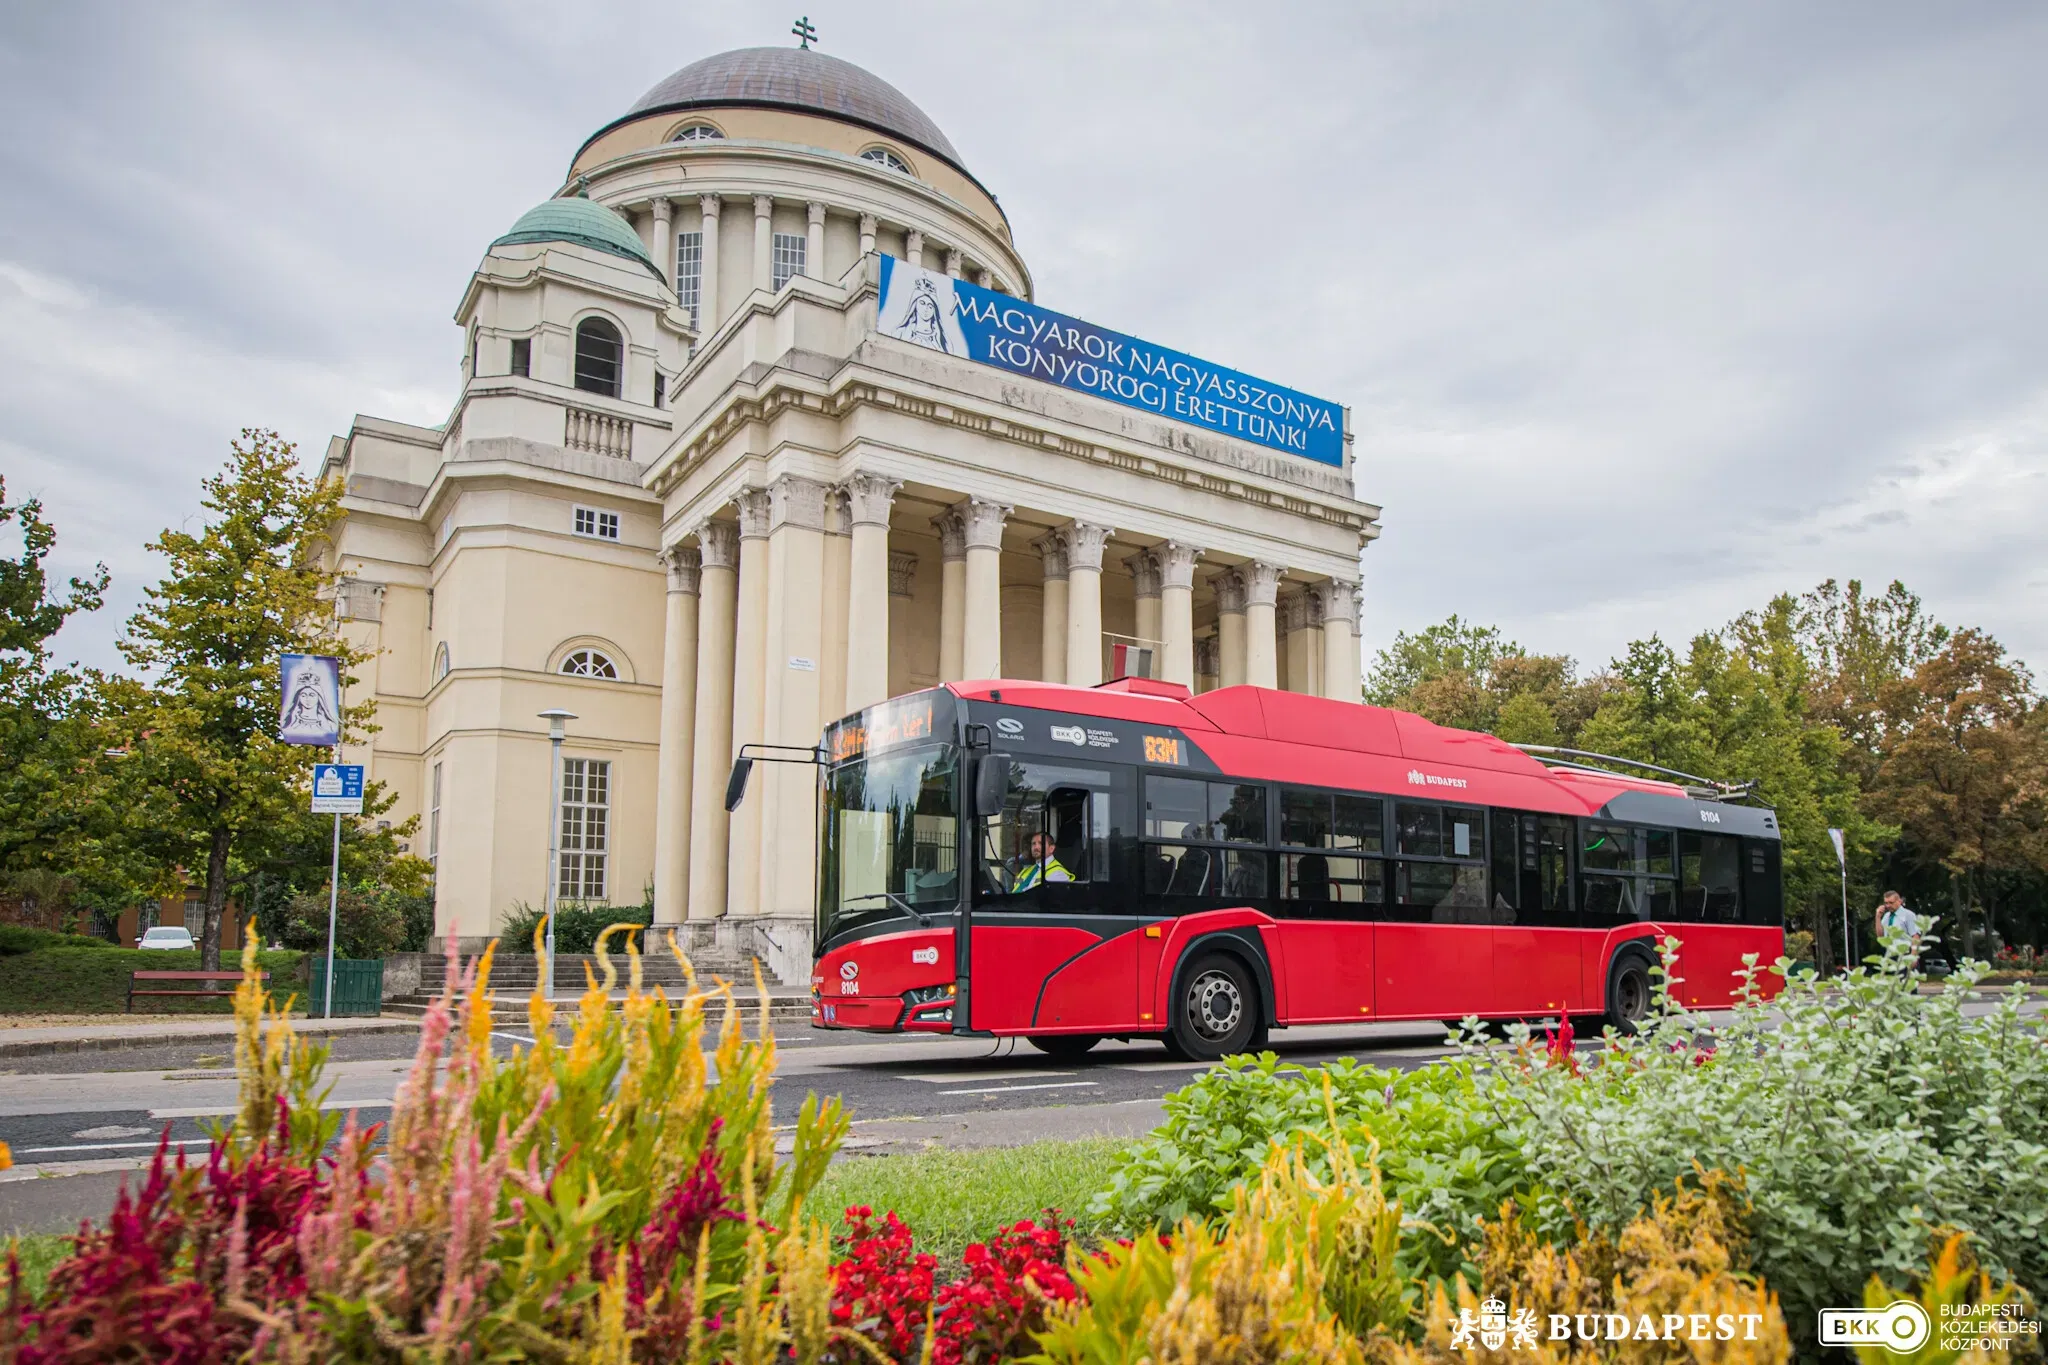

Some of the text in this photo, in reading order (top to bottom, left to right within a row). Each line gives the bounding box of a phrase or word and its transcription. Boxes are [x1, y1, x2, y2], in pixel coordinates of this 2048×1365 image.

[949, 291, 1336, 432] MAGYAROK NAGYASSZONYA
[988, 334, 1307, 450] KÖNYÖRÖGJ ÉRETTÜNK!
[997, 733, 1025, 741] SOLARIS
[1056, 730, 1071, 738] BKK
[1145, 735, 1179, 765] 83M
[1426, 774, 1467, 788] BUDAPEST
[1700, 810, 1720, 823] 8104
[841, 981, 859, 995] 8104
